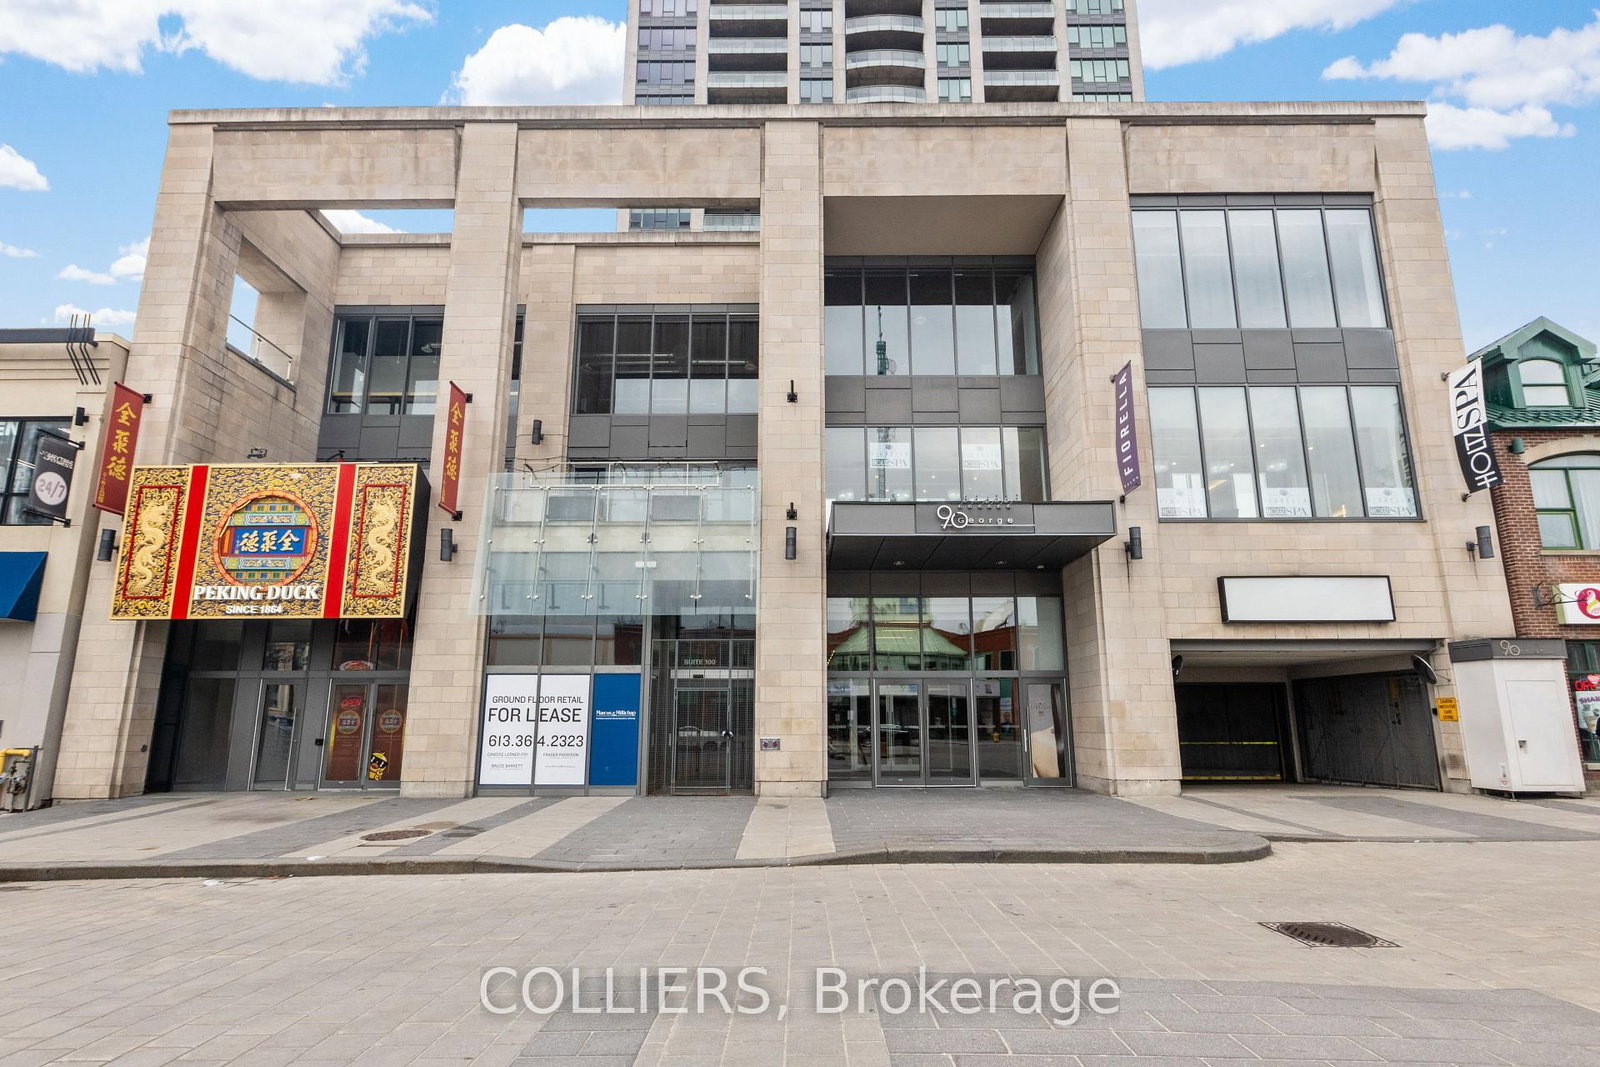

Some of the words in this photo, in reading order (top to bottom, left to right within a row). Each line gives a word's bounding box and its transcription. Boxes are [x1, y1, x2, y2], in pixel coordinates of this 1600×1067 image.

[1454, 364, 1482, 429] SPA
[1119, 372, 1134, 476] FIORELLA
[1463, 423, 1498, 488] HOLTZ
[38, 478, 66, 498] 24/7
[957, 517, 1014, 525] George
[193, 585, 264, 600] PEKING
[266, 585, 320, 600] DUCK
[226, 605, 259, 614] SINCE
[260, 604, 283, 614] 1864
[492, 696, 526, 704] GROUND
[527, 696, 555, 704] FLOOR
[557, 696, 584, 704] RETAIL
[488, 708, 521, 722] FOR
[526, 708, 582, 722] LEASE
[488, 735, 584, 747] 613.364.2323
